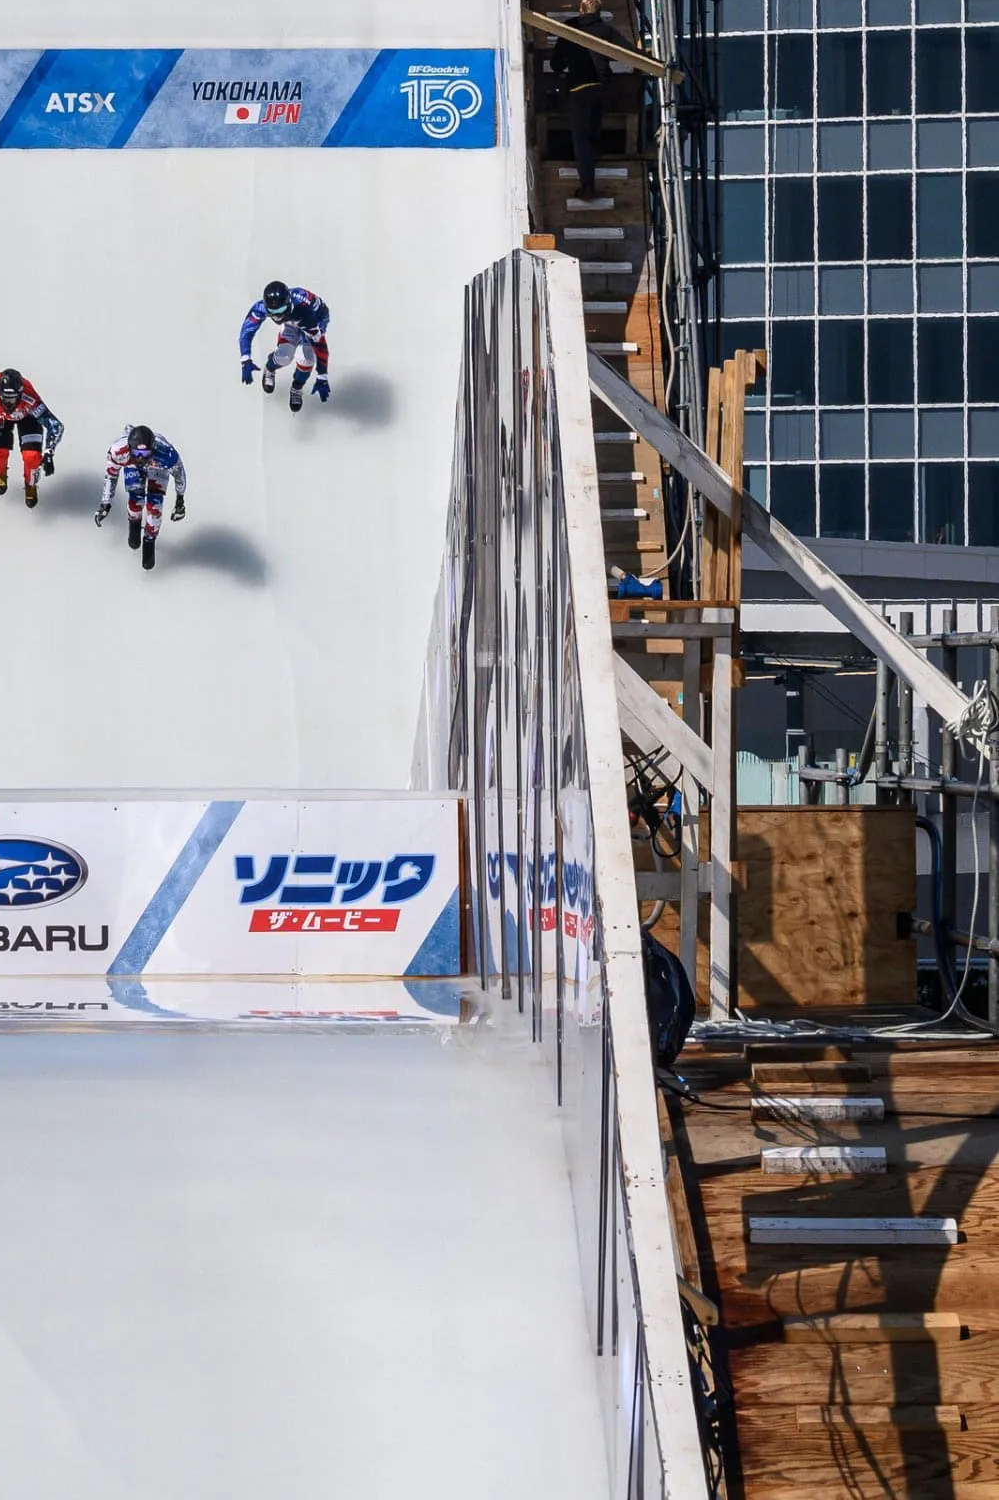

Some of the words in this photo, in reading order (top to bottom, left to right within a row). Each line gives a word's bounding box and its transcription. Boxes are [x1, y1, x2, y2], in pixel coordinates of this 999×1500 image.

[408, 65, 470, 74] BFGoodrich
[192, 82, 302, 101] YOKOHAMA
[45, 93, 115, 113] ATSX
[400, 79, 483, 139] 150
[261, 103, 302, 124] JPN
[234, 854, 436, 904] ソニック
[268, 911, 382, 931] ザ・ムービー
